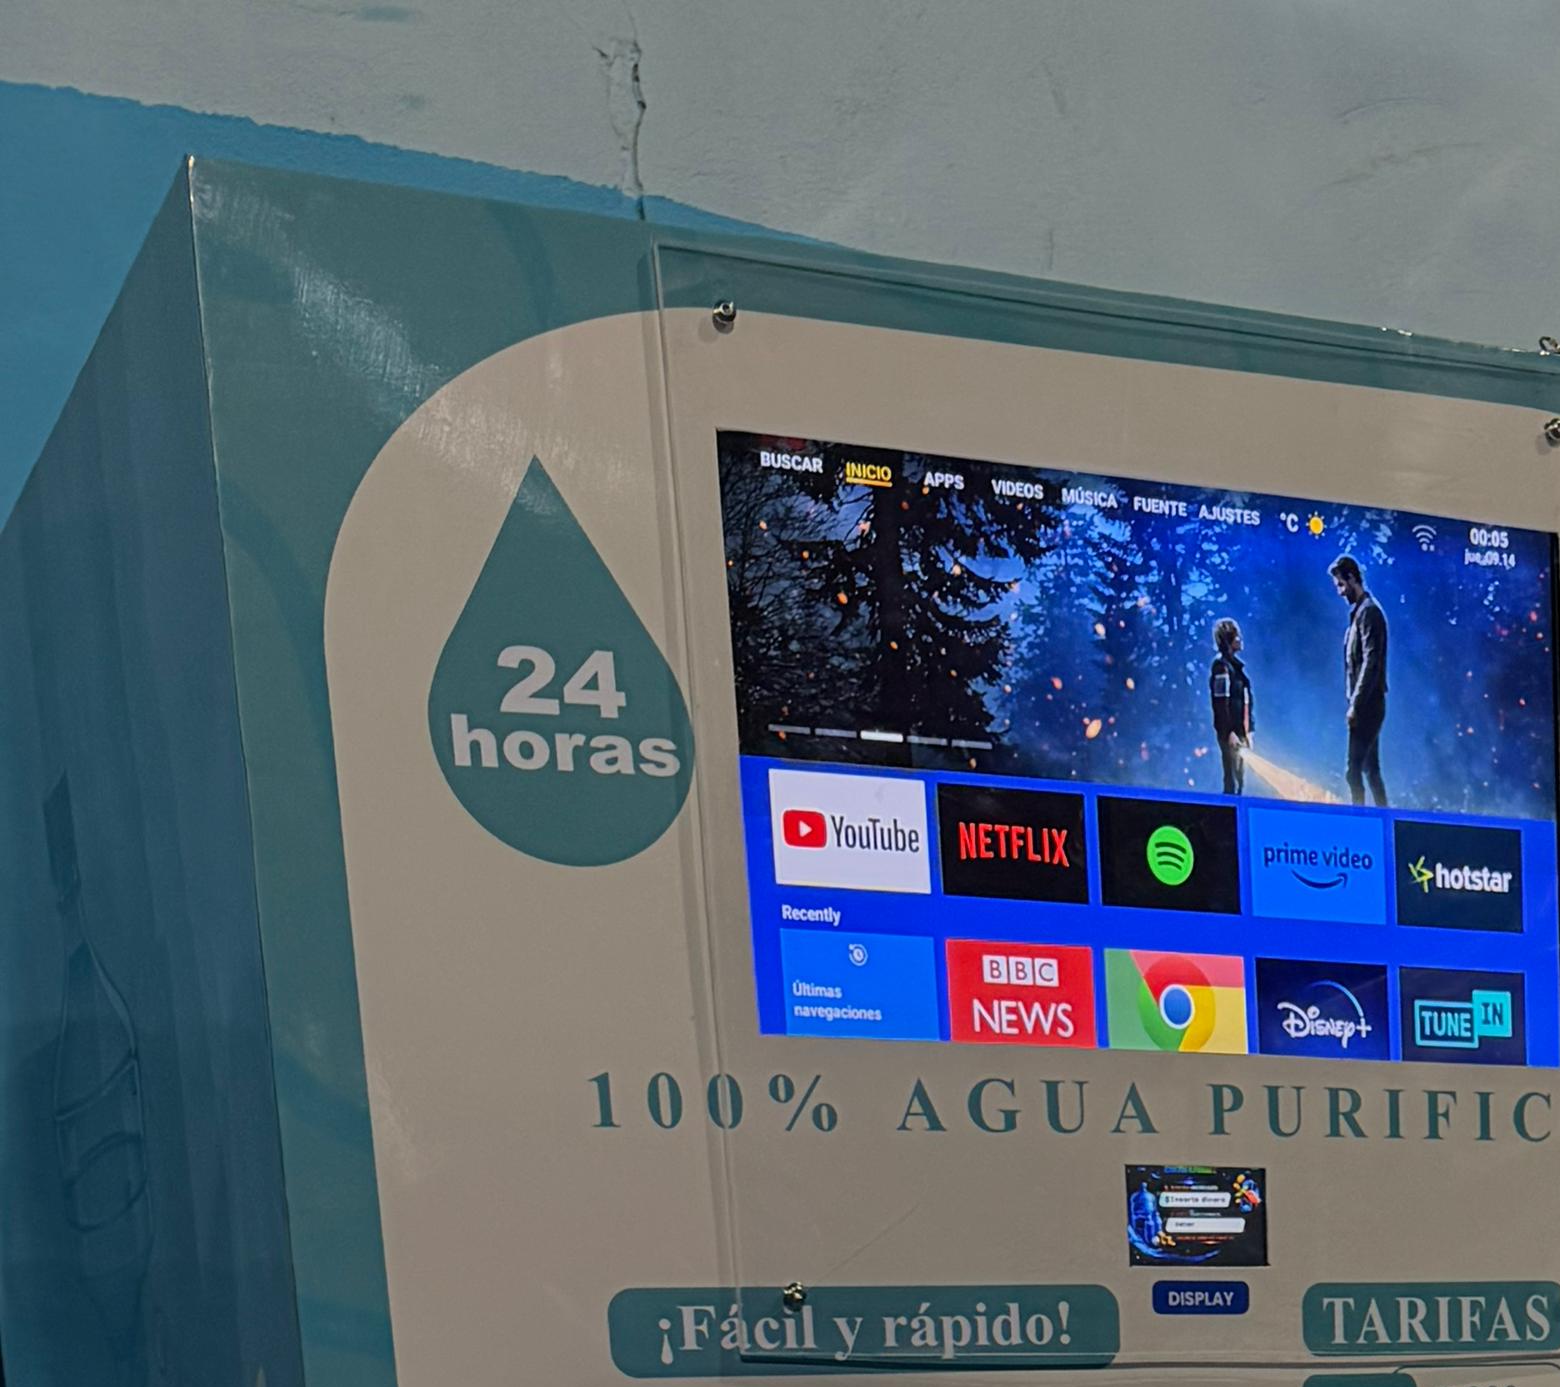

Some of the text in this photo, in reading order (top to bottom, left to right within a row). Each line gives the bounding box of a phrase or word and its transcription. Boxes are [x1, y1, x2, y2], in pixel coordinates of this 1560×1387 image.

[760, 451, 823, 474] BUSCAR
[845, 461, 892, 482] INICIO
[924, 471, 964, 491] APPS
[992, 479, 1044, 500] VIDEOS
[1062, 486, 1118, 509] MÚSICA
[1133, 496, 1187, 518] FUENTE
[1199, 503, 1260, 525] AJUSTES
[1470, 528, 1508, 548] 00:05
[497, 645, 626, 718] 24
[451, 713, 680, 777] horas
[830, 815, 920, 853] YouTube
[959, 822, 1069, 867] NETFLIX
[1264, 842, 1373, 870] prime video
[1436, 862, 1512, 893] hotstar
[781, 905, 841, 926] Recently
[792, 981, 842, 999] Últimas
[987, 958, 1056, 984] BBC
[794, 1004, 882, 1021] navegaciones
[972, 998, 1075, 1038] NEWS
[1421, 1001, 1504, 1038] TUNE IN
[588, 1071, 838, 1132] 100%
[896, 1077, 1159, 1136] AGUA
[1168, 1291, 1234, 1306] DISPLAY
[658, 1300, 1071, 1365] ¡Fácil y rápido!
[1323, 1295, 1551, 1346] TARIFAS
